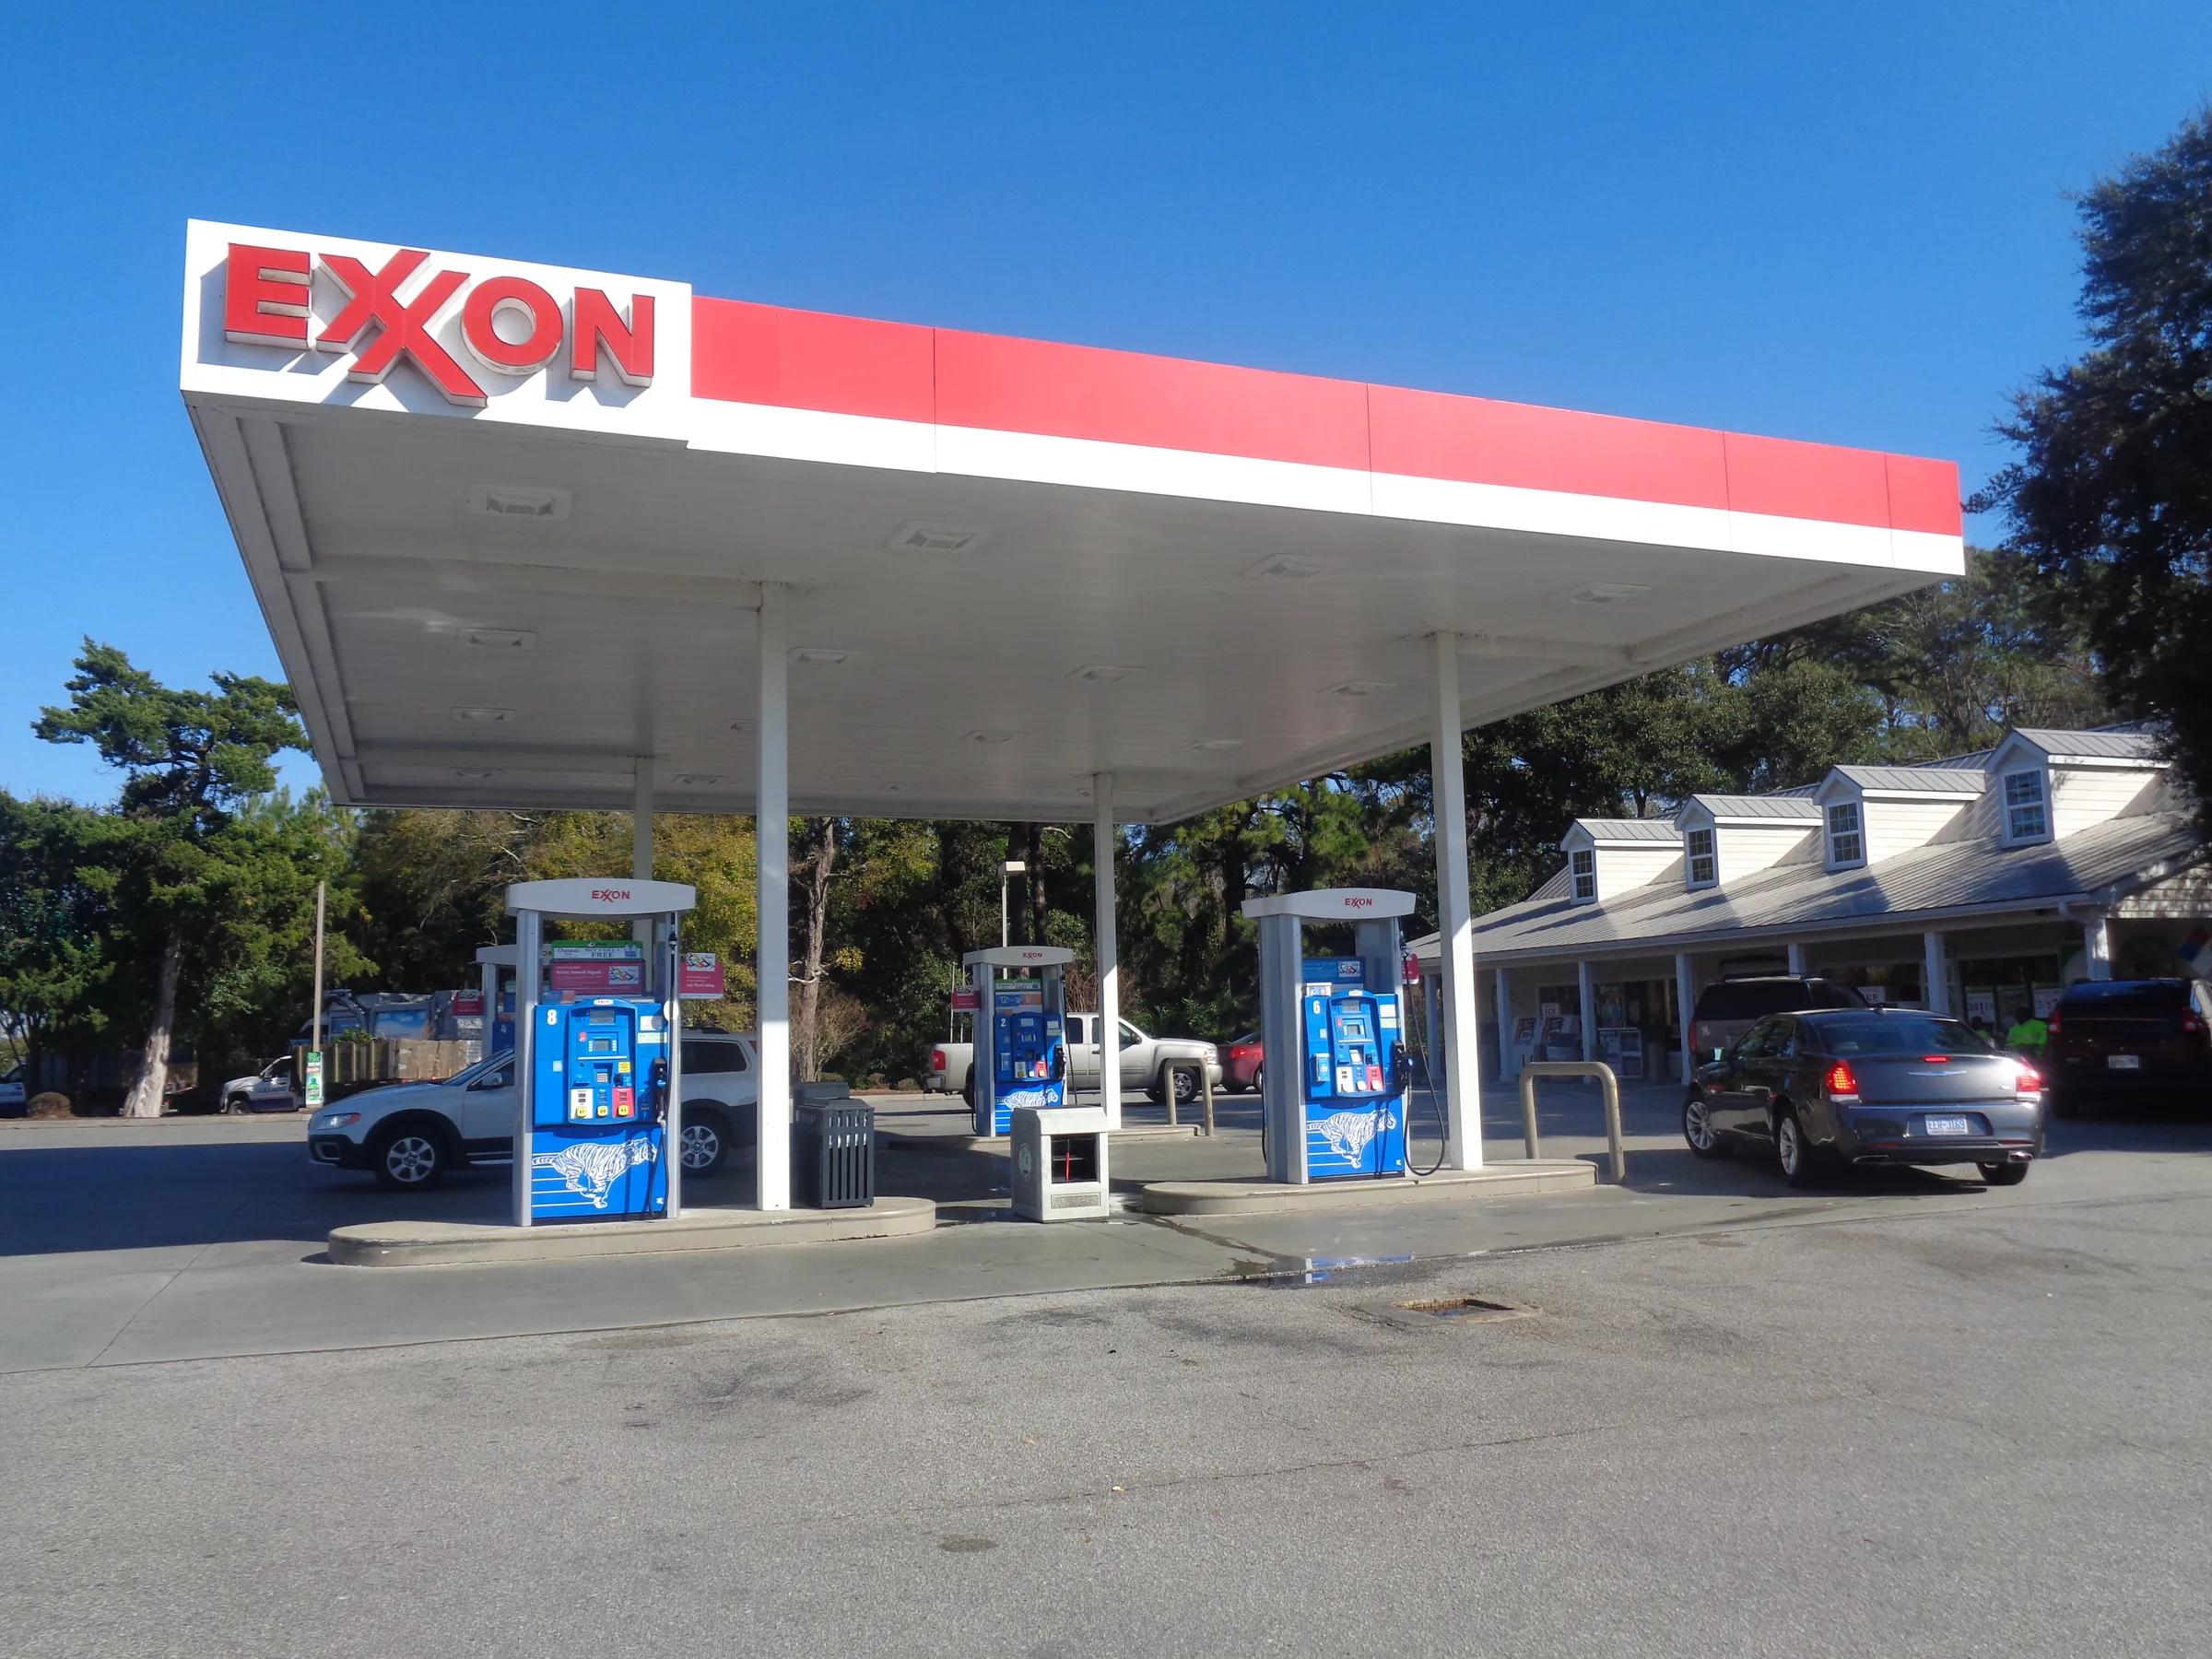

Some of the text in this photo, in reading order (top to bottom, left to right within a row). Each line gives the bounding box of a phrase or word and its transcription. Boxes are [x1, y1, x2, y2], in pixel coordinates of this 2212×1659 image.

[224, 242, 656, 407] EXXON
[591, 888, 630, 902] EXXON
[1345, 897, 1372, 909] EXXON
[1313, 1000, 1321, 1015] 6
[547, 1009, 558, 1025] 8
[1001, 1018, 1006, 1028] 2
